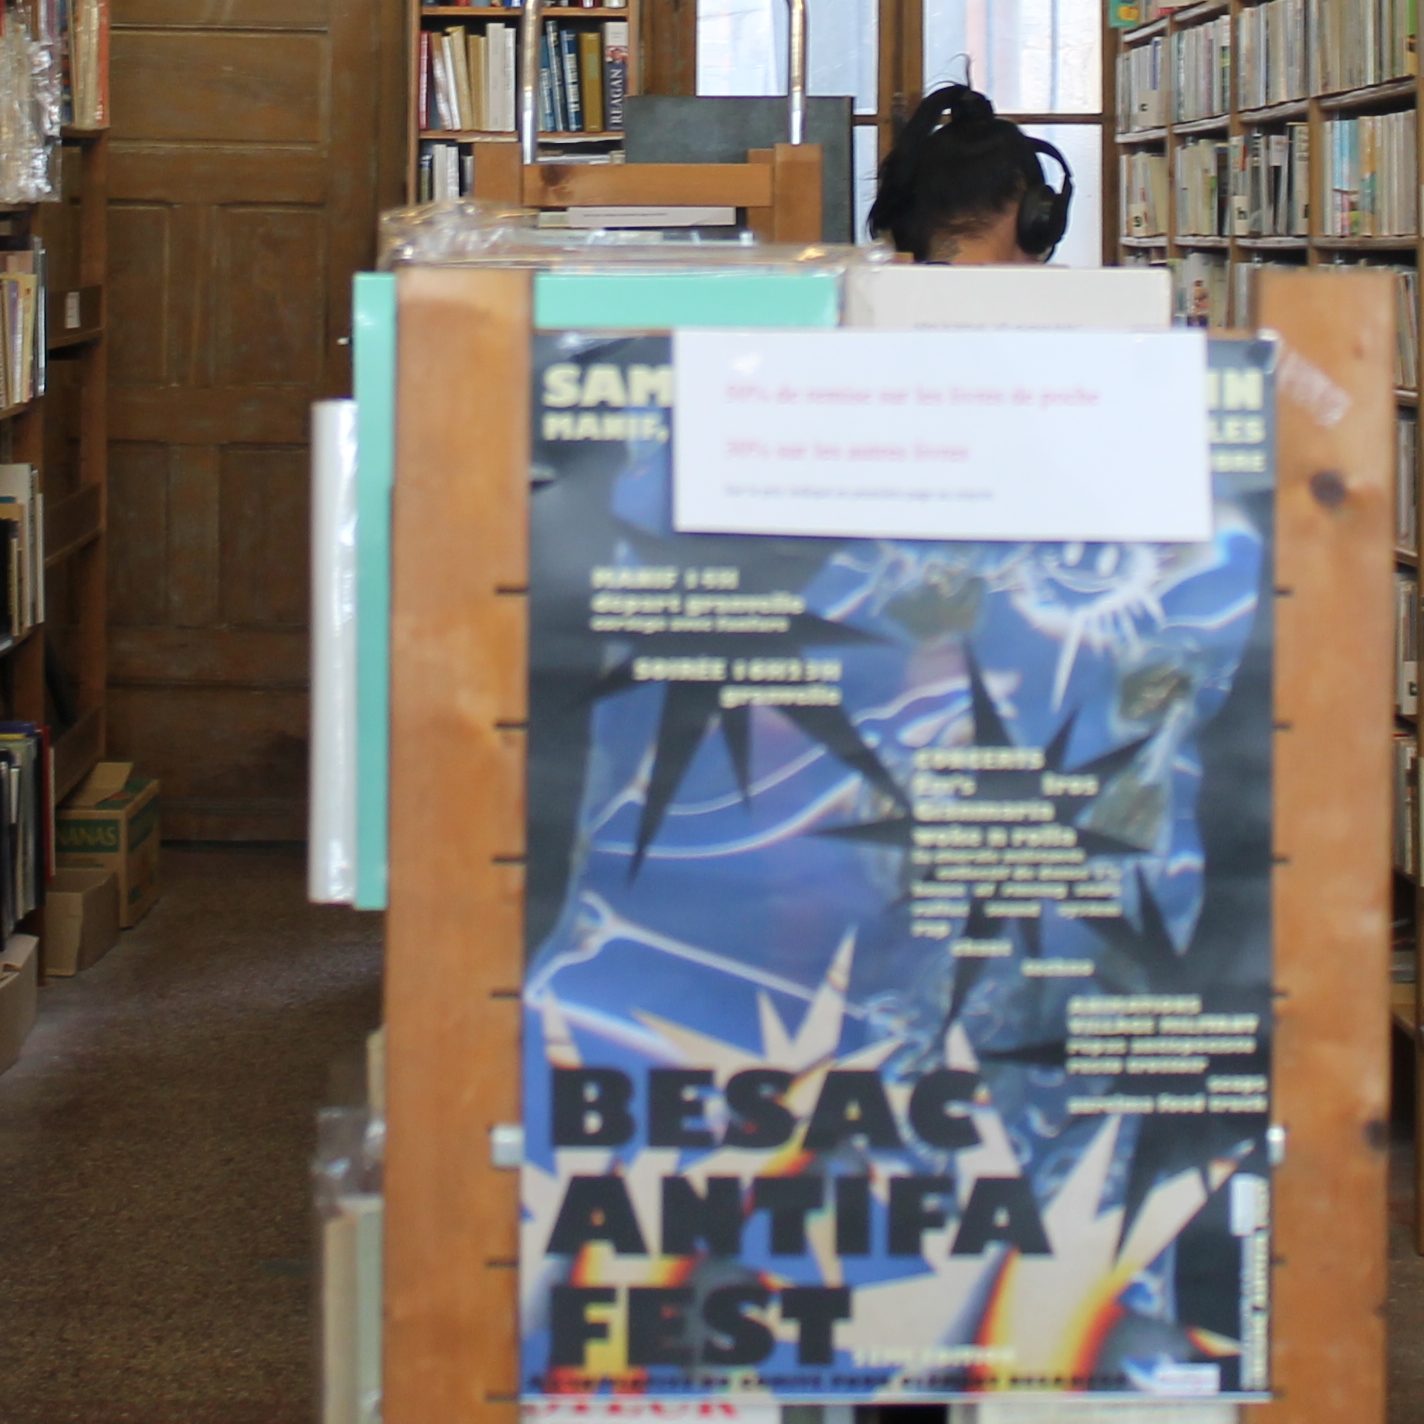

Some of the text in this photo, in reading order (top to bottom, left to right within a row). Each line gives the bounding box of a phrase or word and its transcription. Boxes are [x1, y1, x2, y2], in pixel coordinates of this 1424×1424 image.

[609, 69, 624, 123] REAGAN
[543, 363, 673, 408] SAM
[543, 413, 670, 444] MANIF,
[552, 1068, 983, 1149] BESAC
[545, 1175, 1055, 1256] ANTIFA
[550, 1285, 853, 1367] FEST
